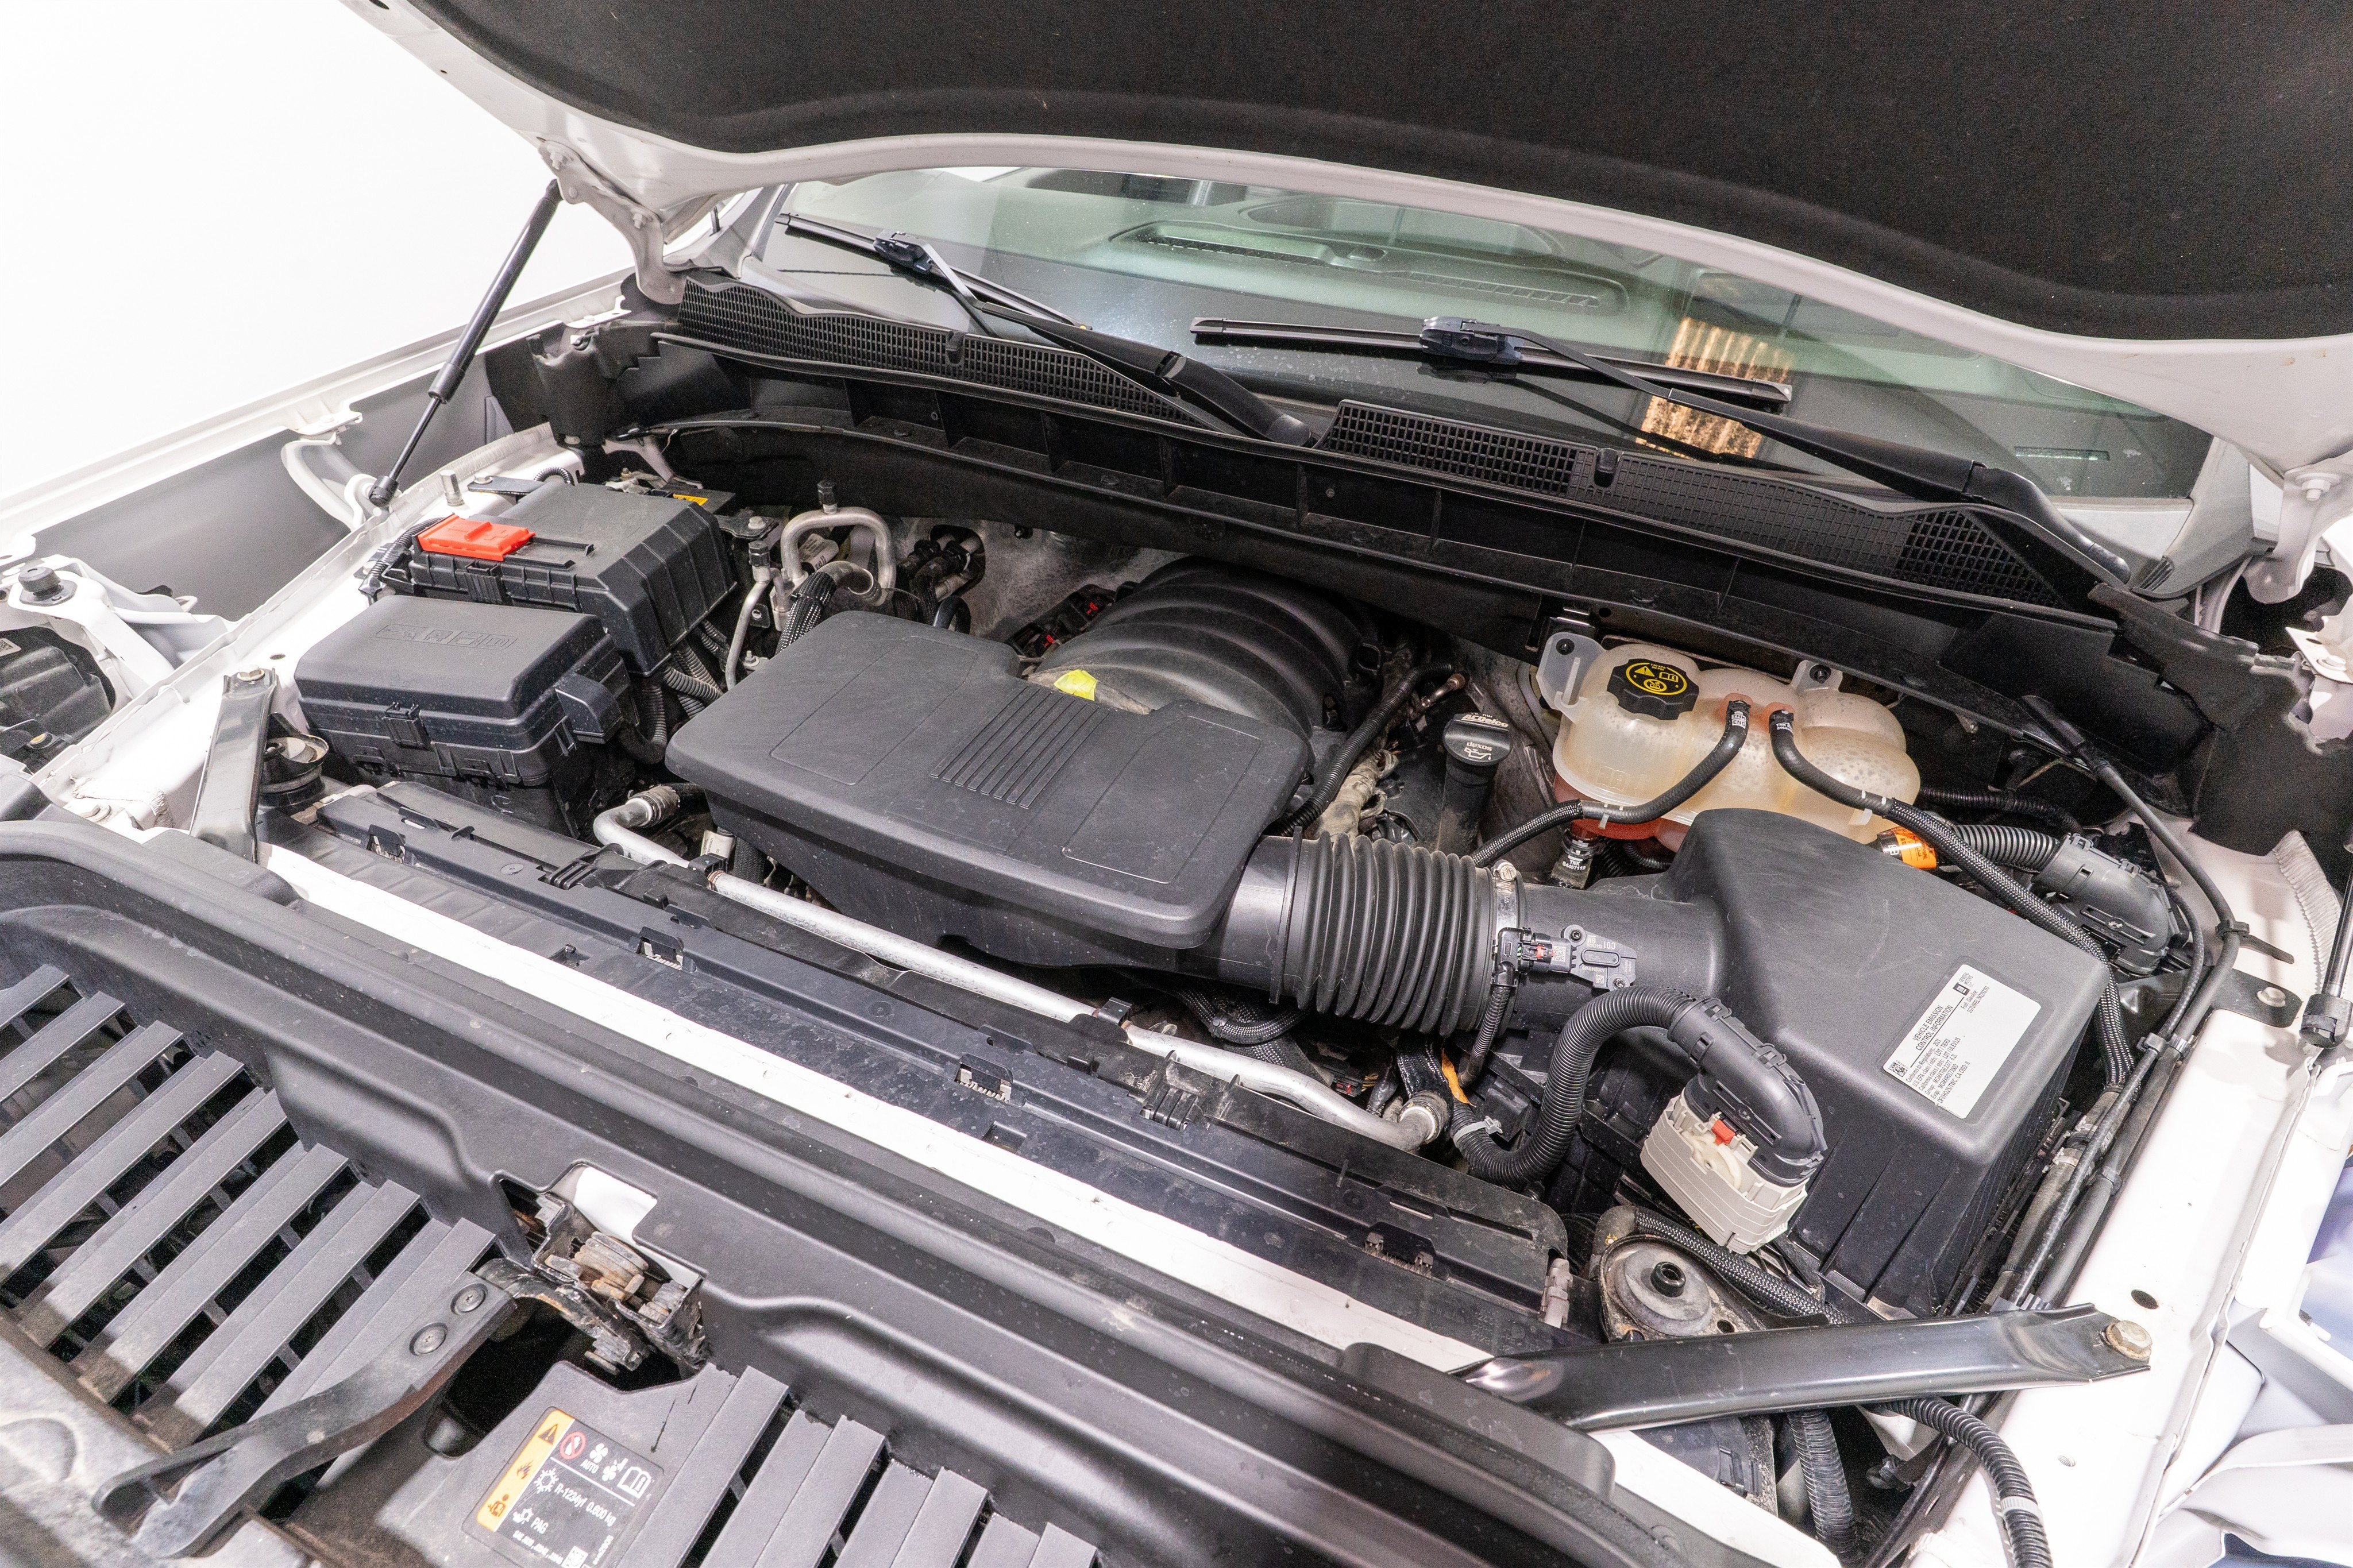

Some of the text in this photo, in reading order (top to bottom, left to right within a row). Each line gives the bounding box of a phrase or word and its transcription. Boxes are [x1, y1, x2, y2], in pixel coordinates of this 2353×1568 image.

[1461, 715, 1509, 727] ACDelco
[1467, 741, 1492, 751] dexos
[1603, 941, 1616, 949] C01
[1966, 990, 1978, 1002] Gasoline
[1912, 1005, 1943, 1041] VEHICLE EMISSION
[1915, 1005, 1953, 1051] CONTROL INFORMATION
[1905, 1068, 1919, 1083] Conforms
[1932, 1038, 1942, 1046] 2021
[1922, 1065, 1931, 1075] class
[1934, 1048, 1943, 1056] LDT
[1941, 1038, 1950, 1048] TIER3
[1918, 1076, 1932, 1091] California
[1930, 1068, 1938, 1077] class
[1942, 1051, 1950, 1059] LDT
[580, 1459, 599, 1474] AUTO
[554, 1483, 616, 1527] R-1234yf 0.600 kg
[530, 1517, 549, 1534] PAG
